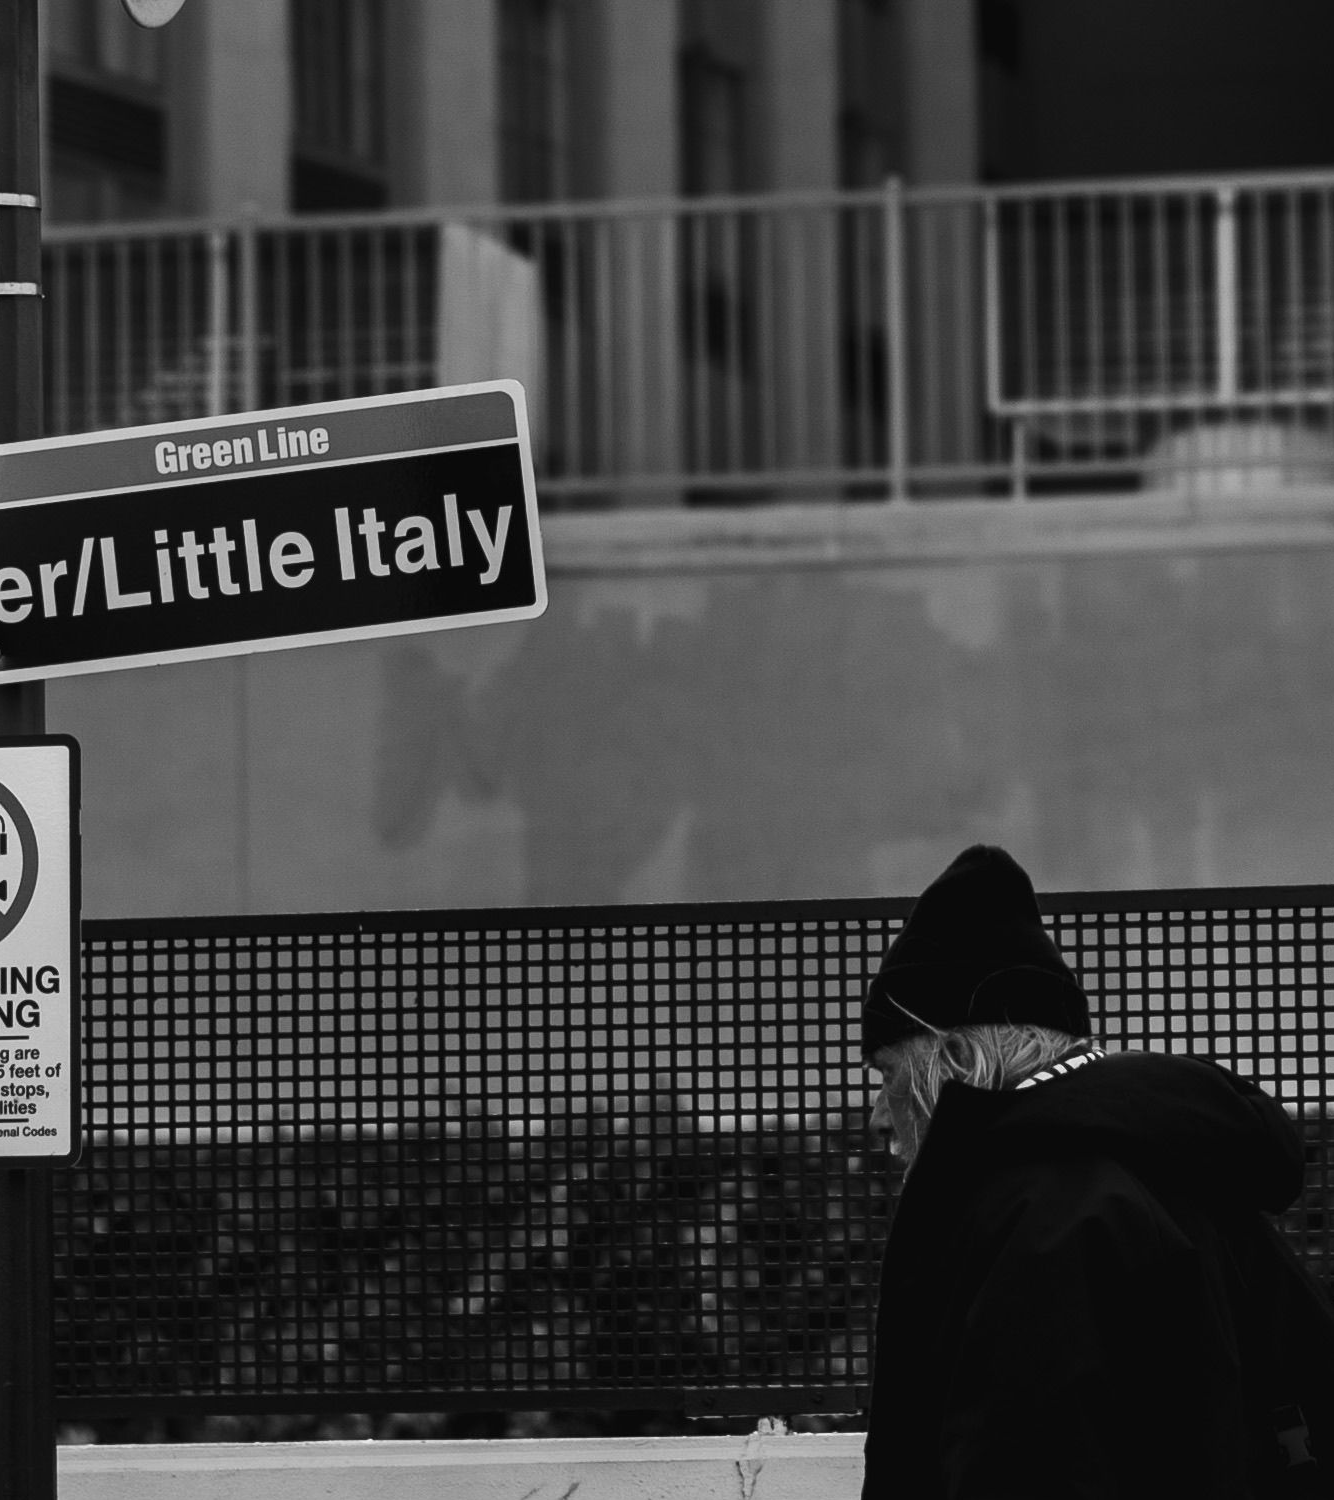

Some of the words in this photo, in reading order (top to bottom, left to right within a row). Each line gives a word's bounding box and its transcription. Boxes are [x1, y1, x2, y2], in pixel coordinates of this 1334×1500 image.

[155, 436, 253, 474] Green
[258, 426, 330, 462] Line
[335, 493, 513, 585] Italy
[14, 1048, 40, 1060] are
[9, 1063, 40, 1078] feet
[45, 1063, 61, 1077] of
[0, 1083, 50, 1099] stops,
[22, 1125, 57, 1137] Codes
